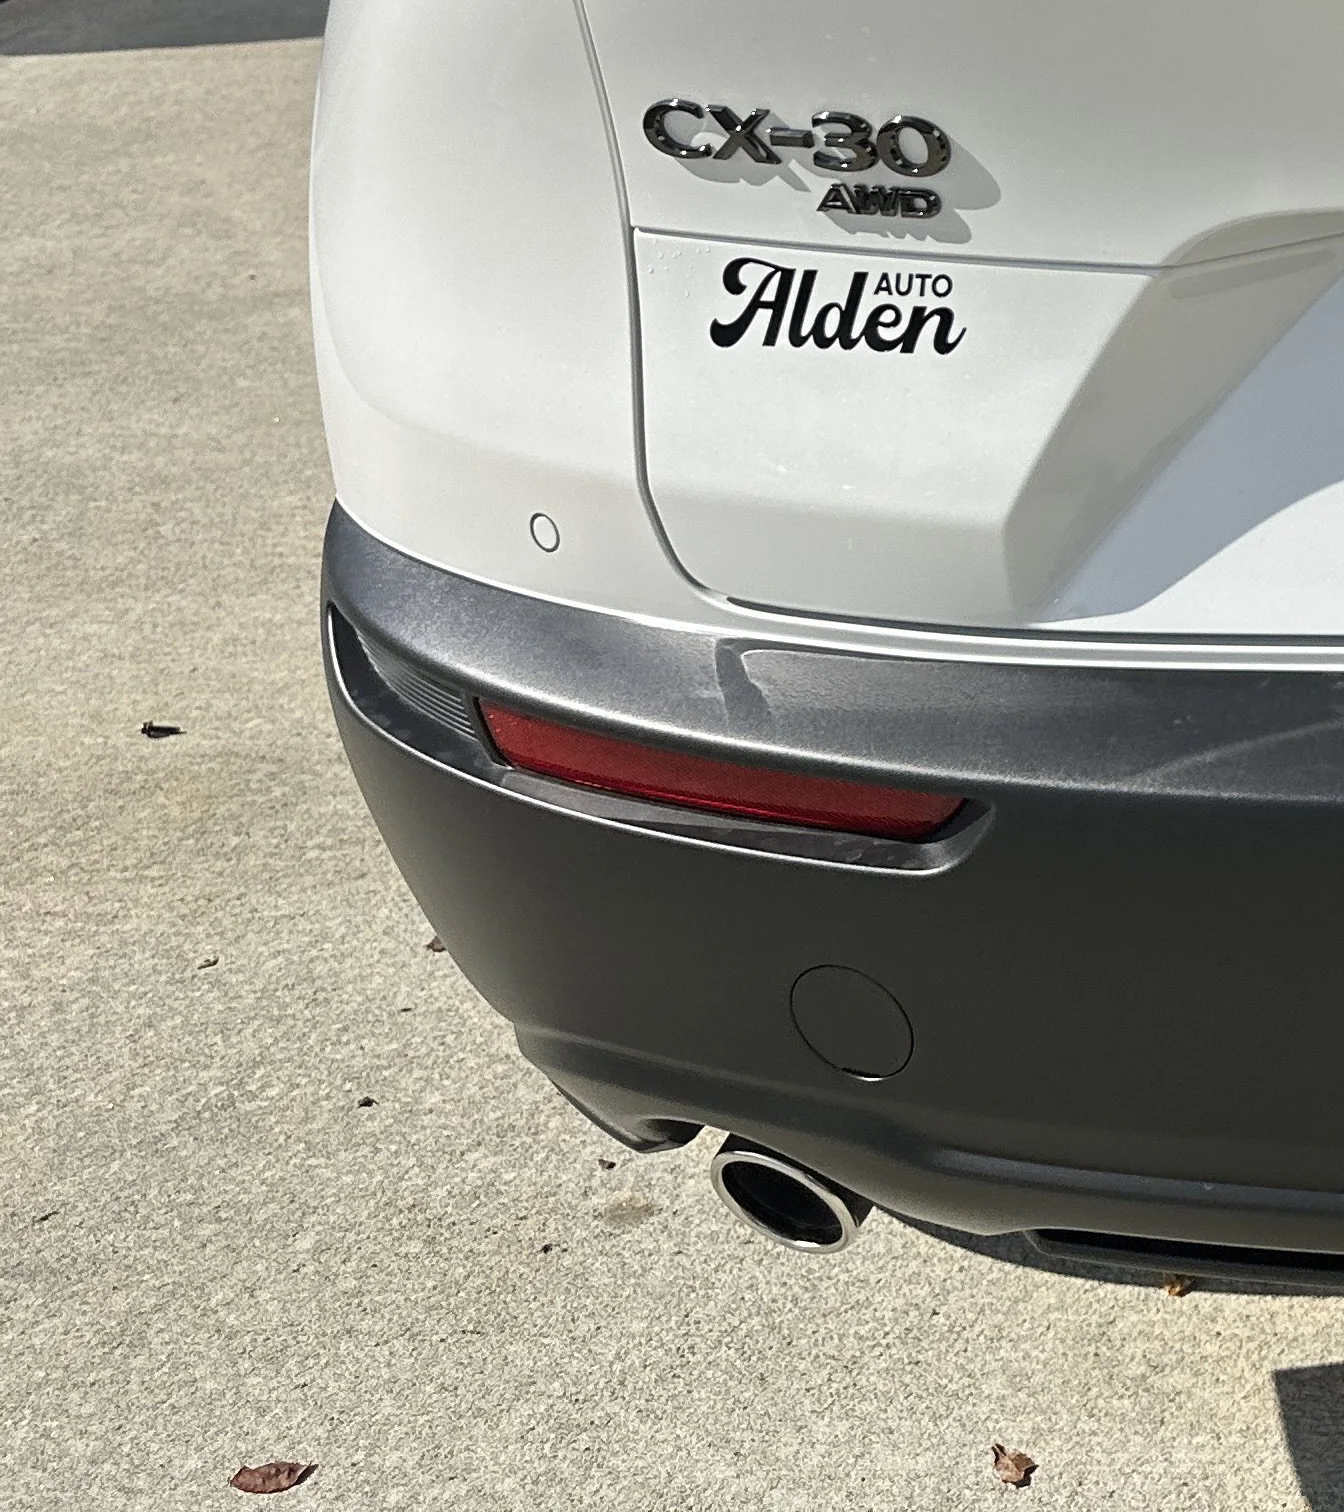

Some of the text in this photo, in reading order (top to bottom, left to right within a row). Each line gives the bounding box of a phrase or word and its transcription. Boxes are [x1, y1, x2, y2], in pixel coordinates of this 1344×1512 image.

[642, 98, 952, 178] CX-30
[816, 183, 943, 219] AWD
[710, 257, 967, 355] Alden
[873, 272, 953, 298] AUTO
